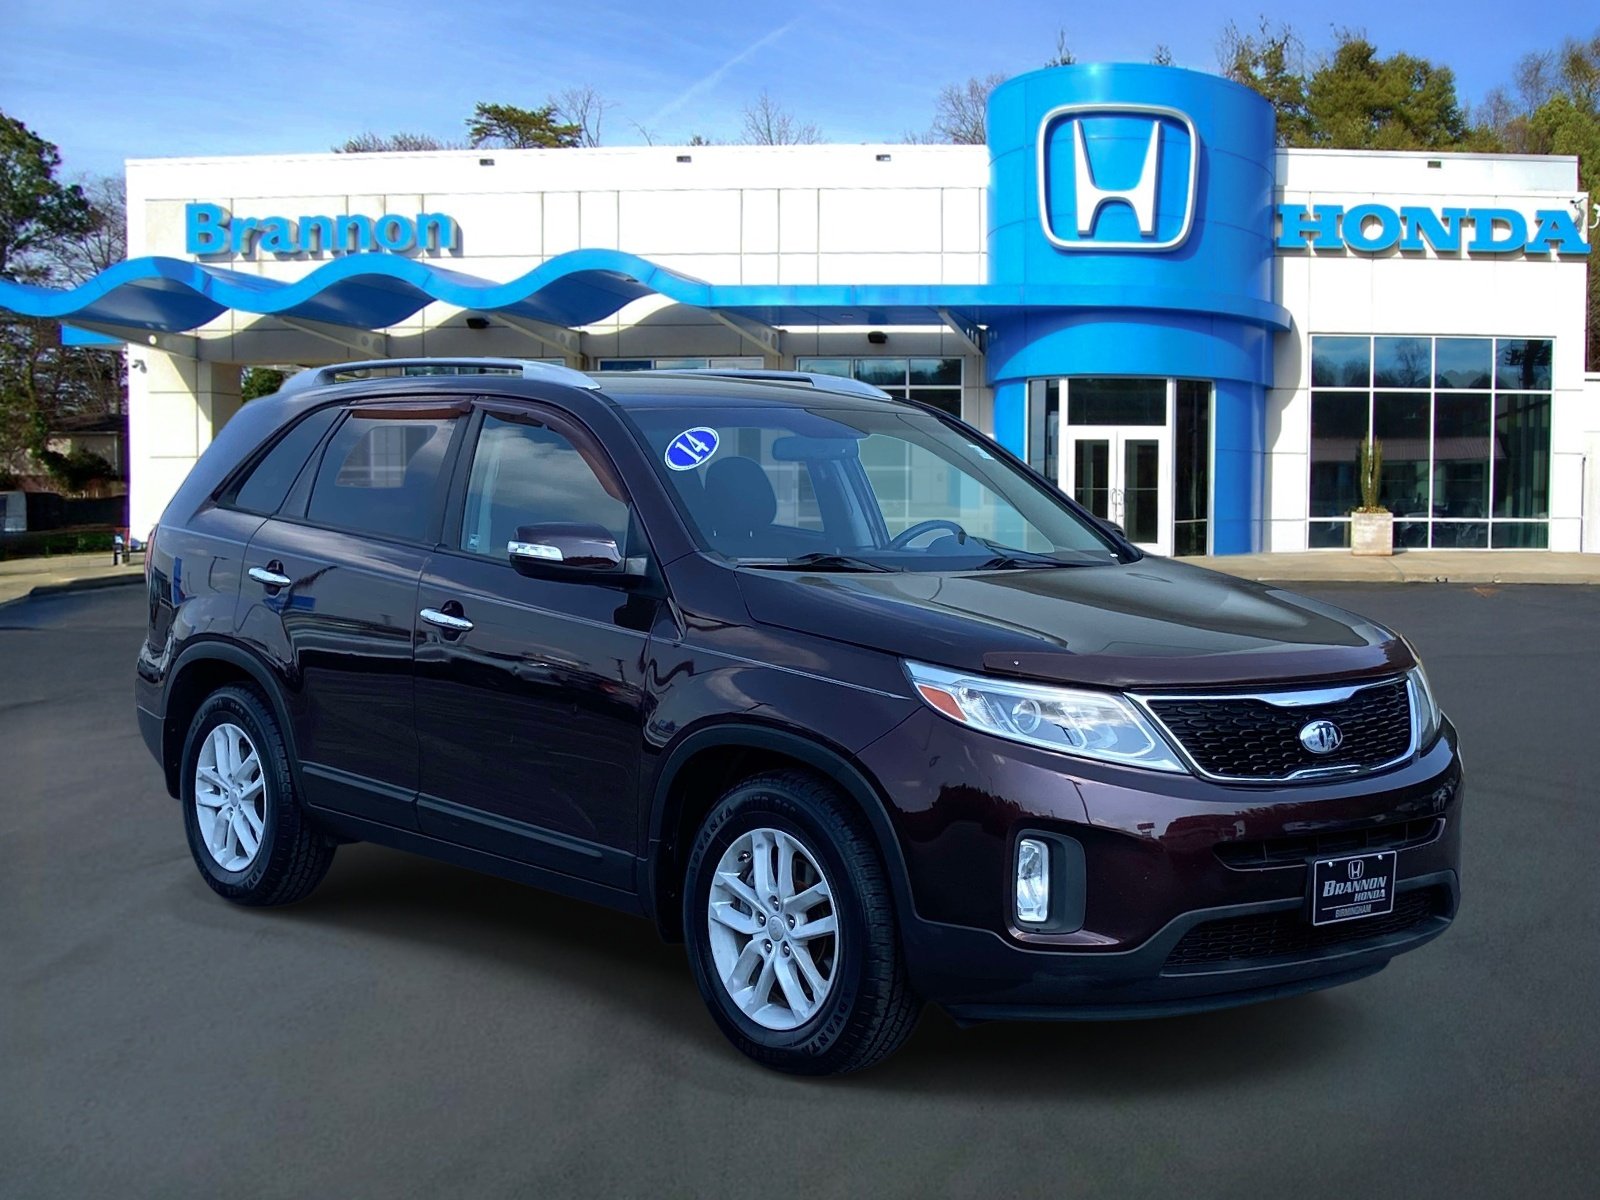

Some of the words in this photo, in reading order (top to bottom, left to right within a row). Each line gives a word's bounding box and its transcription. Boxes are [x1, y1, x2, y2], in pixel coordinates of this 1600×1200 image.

[185, 203, 459, 256] Brannon
[1276, 203, 1592, 256] HONDA
[674, 432, 710, 463] 14
[1322, 876, 1387, 897] BRANNON
[1354, 889, 1386, 902] HONDA
